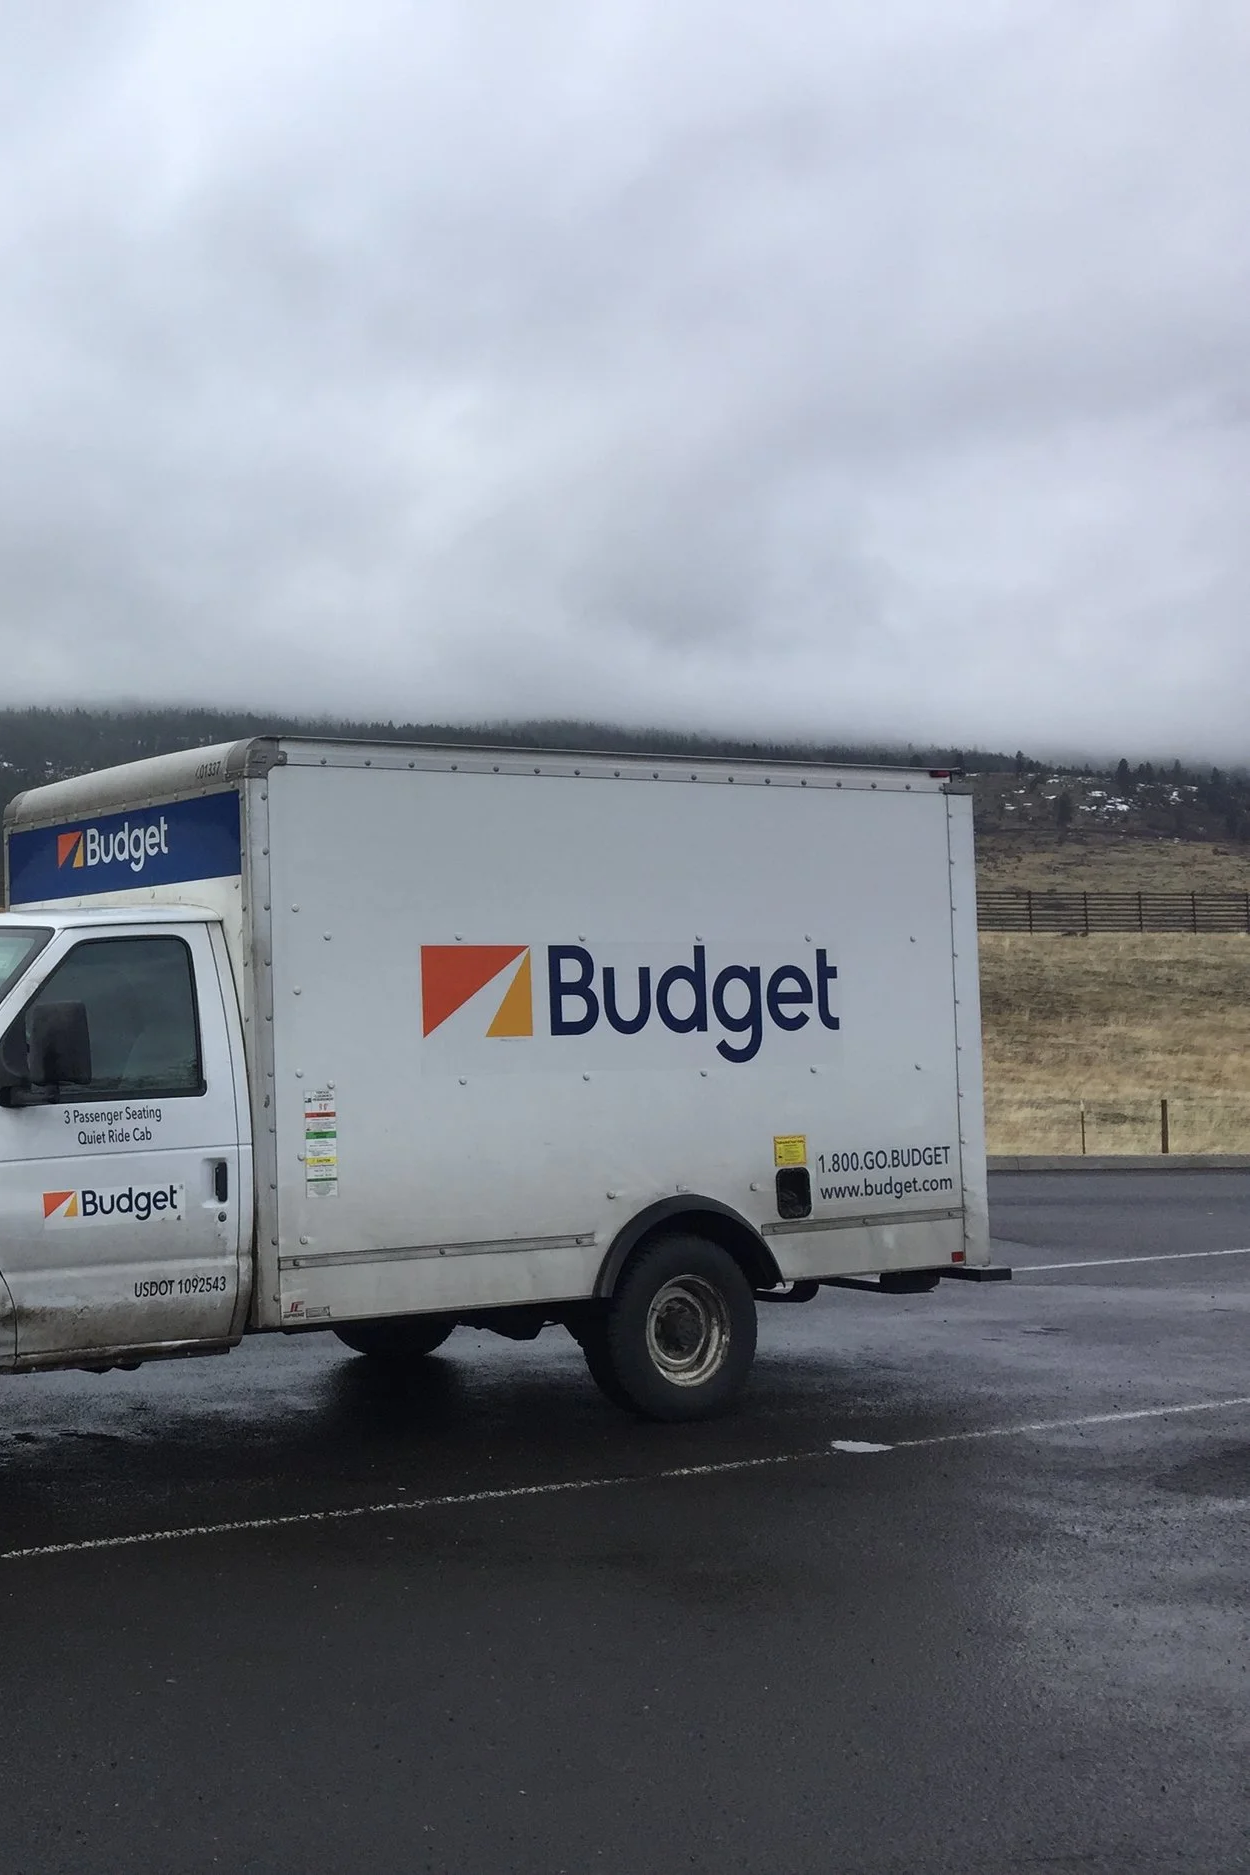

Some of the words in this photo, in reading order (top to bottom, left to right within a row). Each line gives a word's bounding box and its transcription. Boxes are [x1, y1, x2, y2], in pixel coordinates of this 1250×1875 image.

[86, 816, 168, 872] Budget
[547, 945, 840, 1063] Budget
[64, 1110, 71, 1125] 3
[73, 1109, 124, 1126] Passenger
[125, 1106, 162, 1122] Seating
[77, 1130, 106, 1145] Quiet
[108, 1128, 131, 1144] Ride
[132, 1126, 152, 1141] Cab
[818, 1146, 950, 1174] 1.800.GO.BUDGET
[820, 1176, 953, 1200] www.budget.com
[81, 1184, 178, 1221] Budget
[134, 1279, 175, 1298] USDOT
[177, 1275, 227, 1294] 1092543
